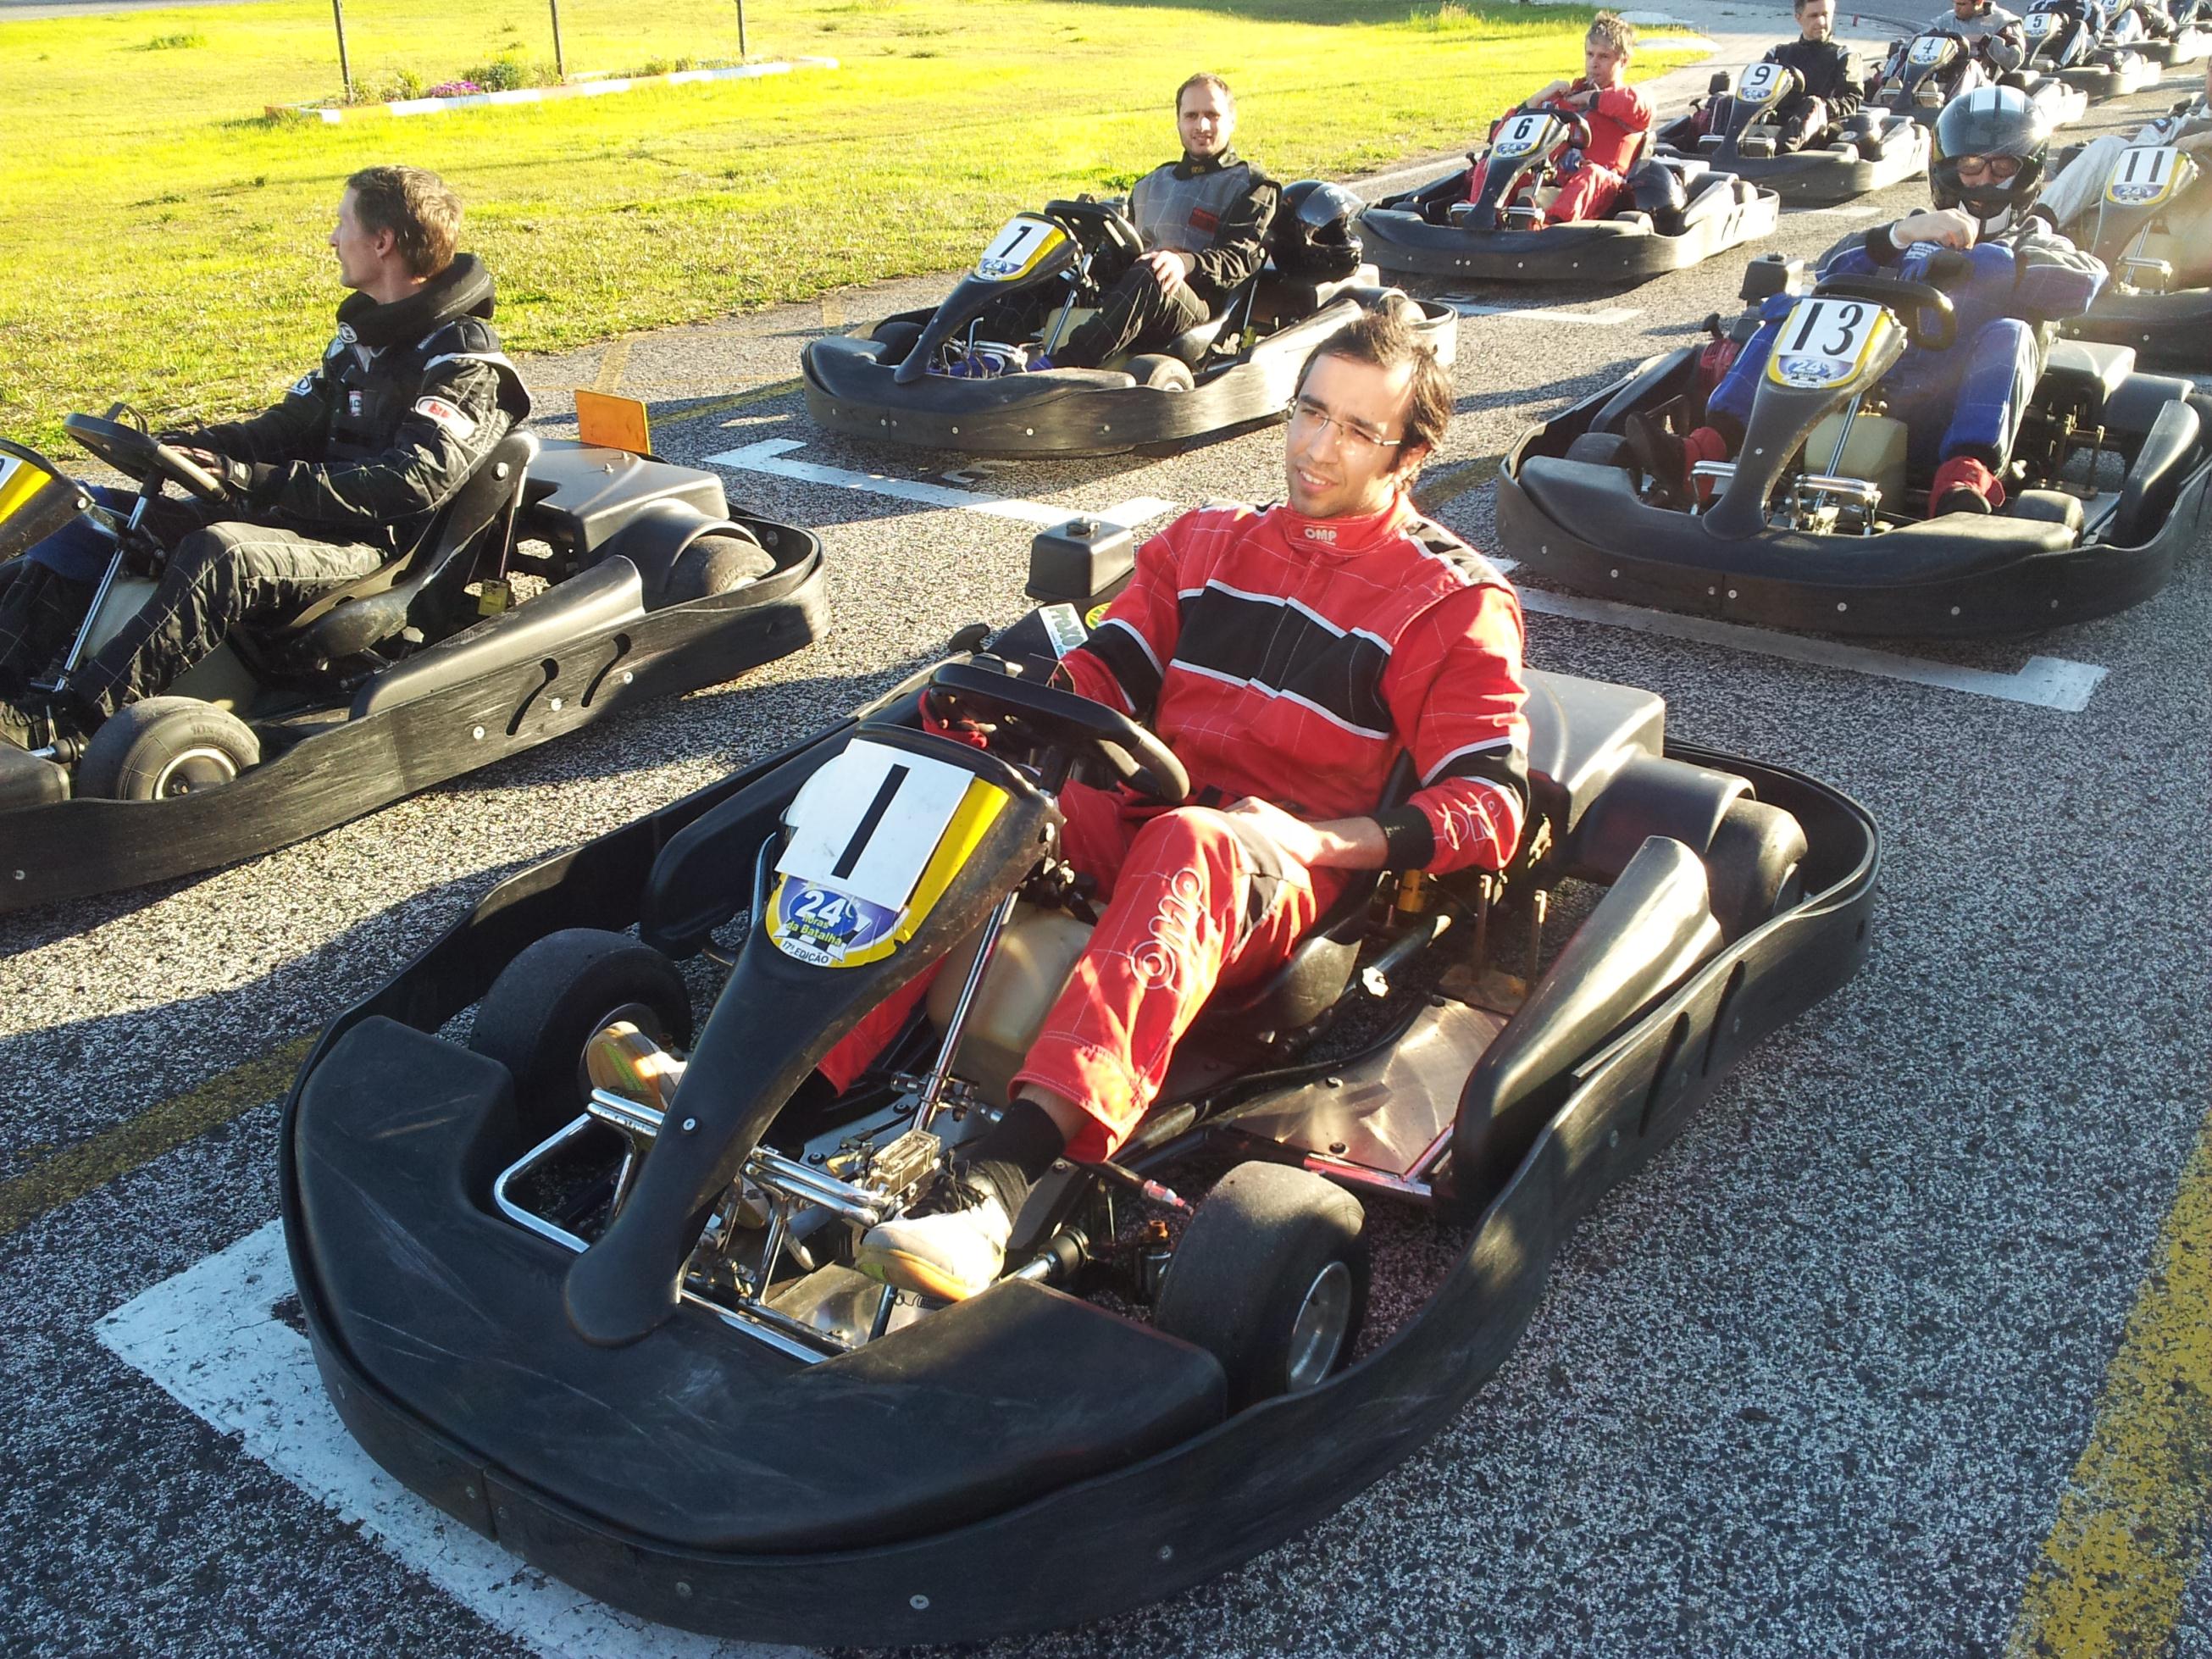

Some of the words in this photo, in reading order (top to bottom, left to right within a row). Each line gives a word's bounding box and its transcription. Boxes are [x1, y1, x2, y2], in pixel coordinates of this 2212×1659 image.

[2032, 14, 2043, 28] 5
[1923, 38, 1936, 53] 4
[1749, 65, 1771, 86] 9
[1513, 117, 1534, 140] 6
[2124, 151, 2165, 182] 11
[1792, 302, 1864, 356] 13
[1305, 527, 1338, 541] OMP
[830, 763, 911, 880] 1
[786, 920, 799, 932] da
[801, 924, 842, 946] Batalha
[795, 948, 829, 963] EDIÇÃO
